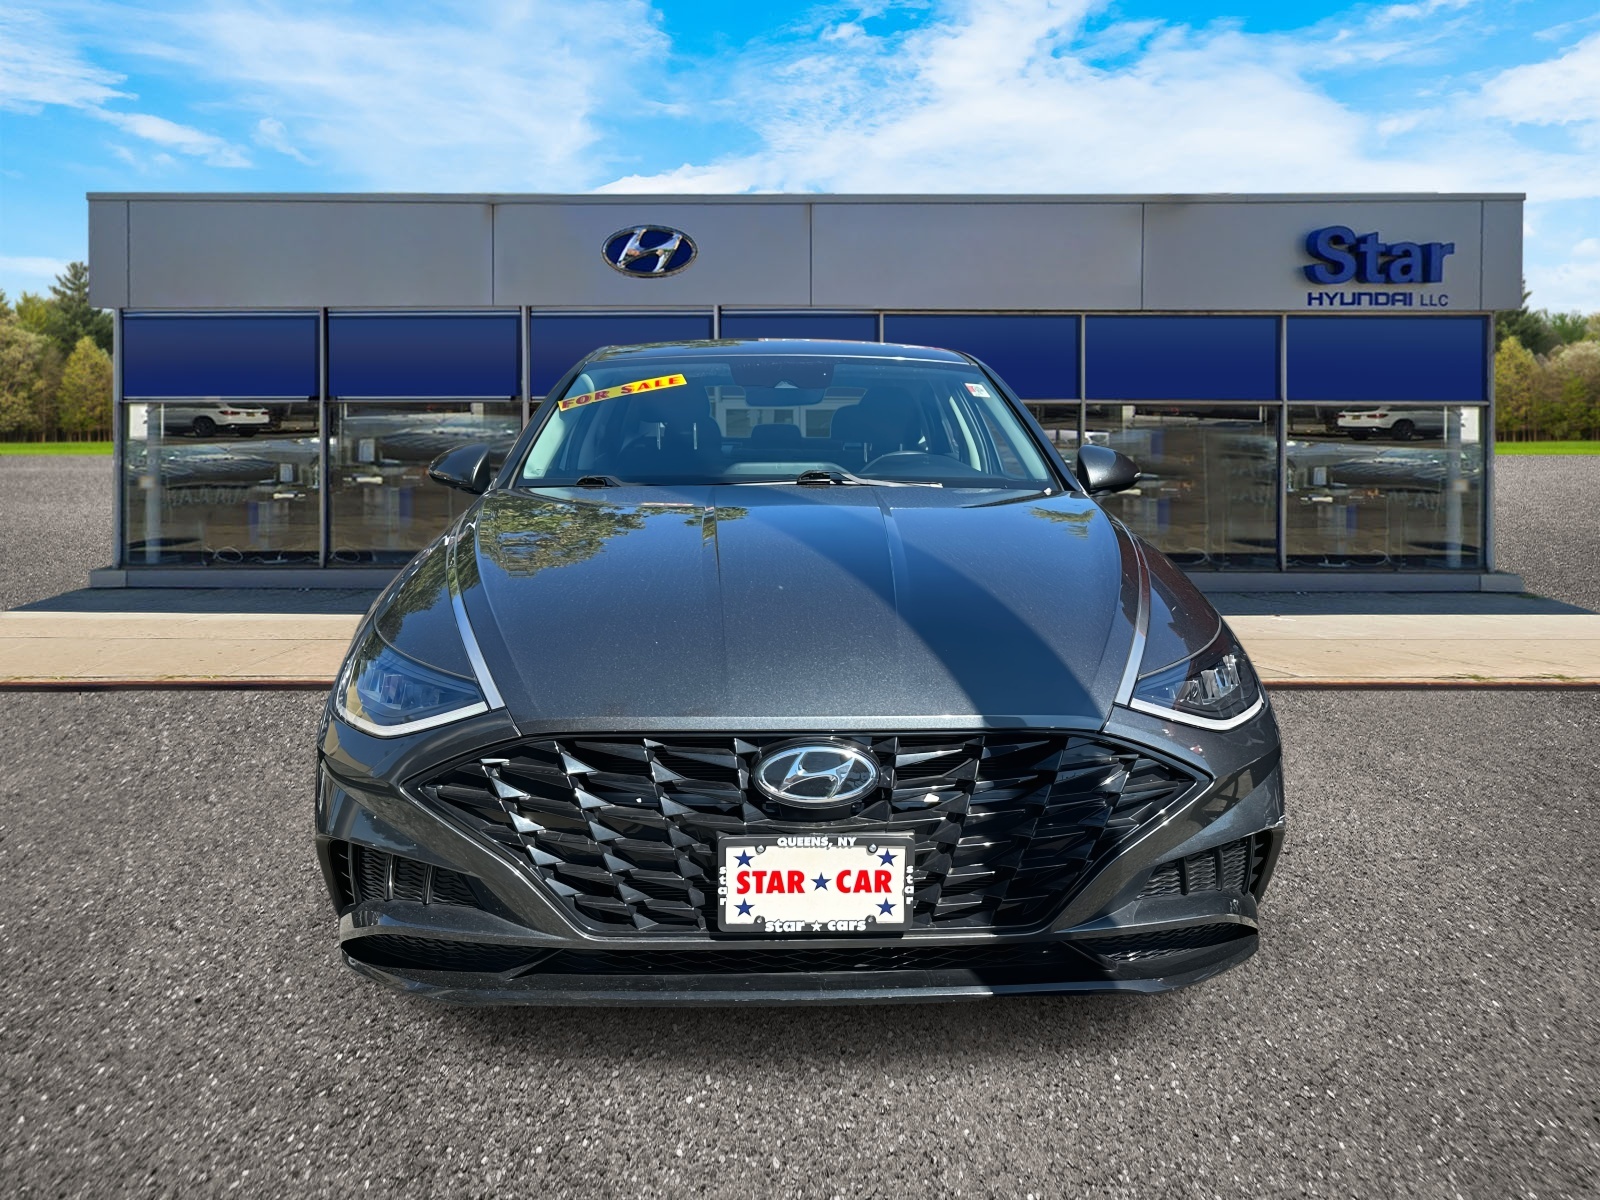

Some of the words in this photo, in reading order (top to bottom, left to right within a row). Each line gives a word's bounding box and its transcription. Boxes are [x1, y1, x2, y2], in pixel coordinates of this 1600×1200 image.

[1303, 225, 1455, 285] Star
[1307, 292, 1413, 306] HYUNDAI
[1420, 294, 1448, 306] LLC
[561, 391, 610, 409] FOR
[620, 376, 682, 394] SALE
[777, 837, 833, 848] QUEENS,
[837, 837, 857, 847] NY
[736, 870, 805, 894] STAR
[836, 869, 892, 893] CAR
[905, 865, 914, 905] star
[765, 919, 805, 932] star
[827, 919, 867, 931] cars
